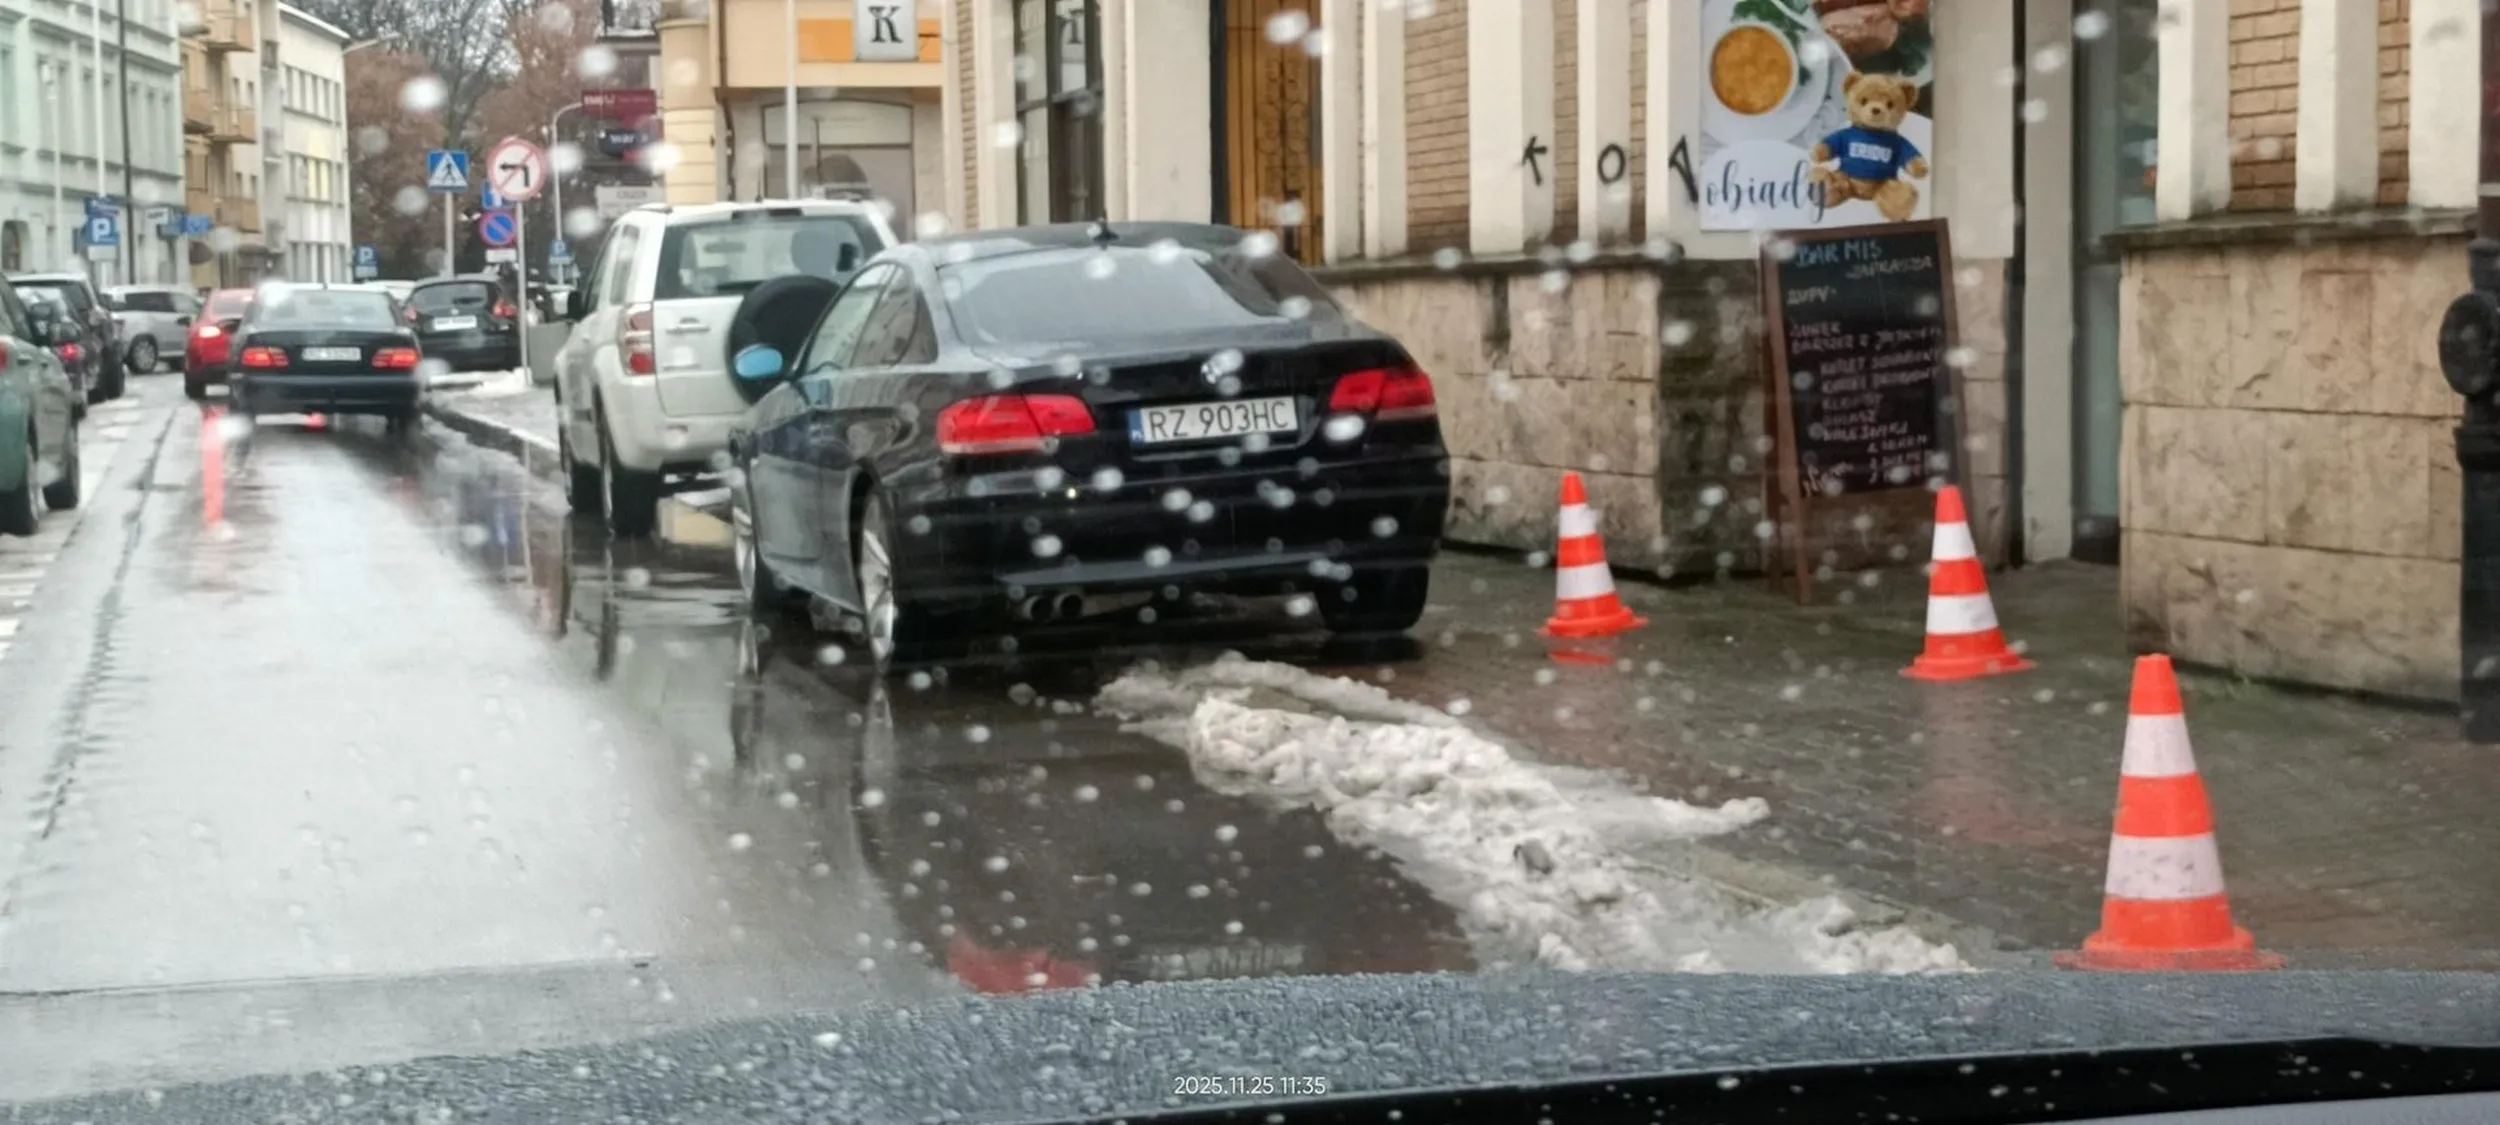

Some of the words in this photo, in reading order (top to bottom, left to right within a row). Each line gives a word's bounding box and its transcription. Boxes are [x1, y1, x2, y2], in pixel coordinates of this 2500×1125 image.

[868, 6, 904, 43] K
[1706, 160, 1826, 223] obiady
[1796, 242, 1841, 268] BAR
[1149, 408, 1188, 440] RZ
[1199, 400, 1289, 437] 903HC
